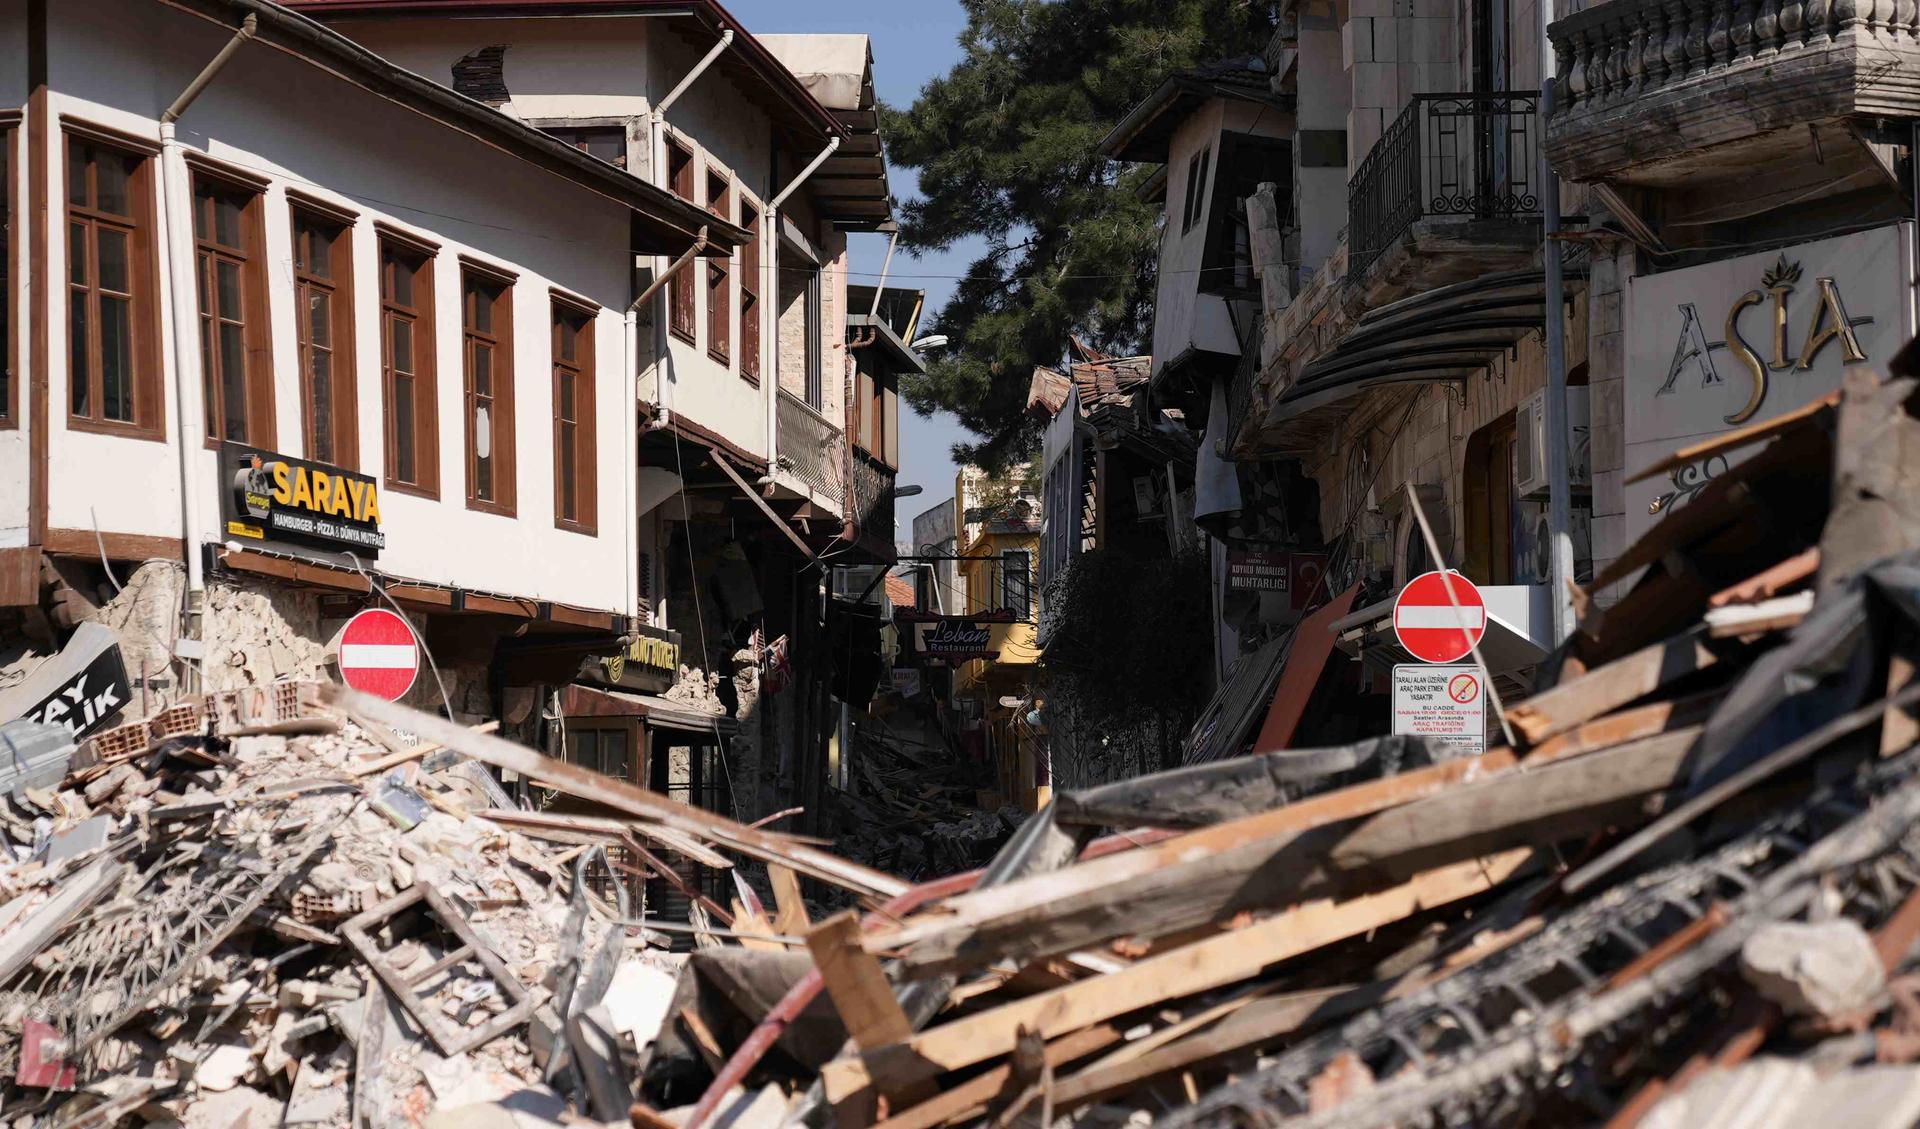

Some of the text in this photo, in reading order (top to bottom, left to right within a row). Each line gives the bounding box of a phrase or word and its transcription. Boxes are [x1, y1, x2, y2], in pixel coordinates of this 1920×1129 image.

[273, 461, 381, 525] SARAYA
[274, 513, 313, 533] HAMBURGER
[317, 521, 335, 537] PİZZA
[340, 525, 360, 542] DÜNYA
[931, 643, 985, 652] Restaurant
[1396, 674, 1448, 684] TARALI ALAN ÜZERİNE
[1400, 685, 1414, 693] ARAÇ
